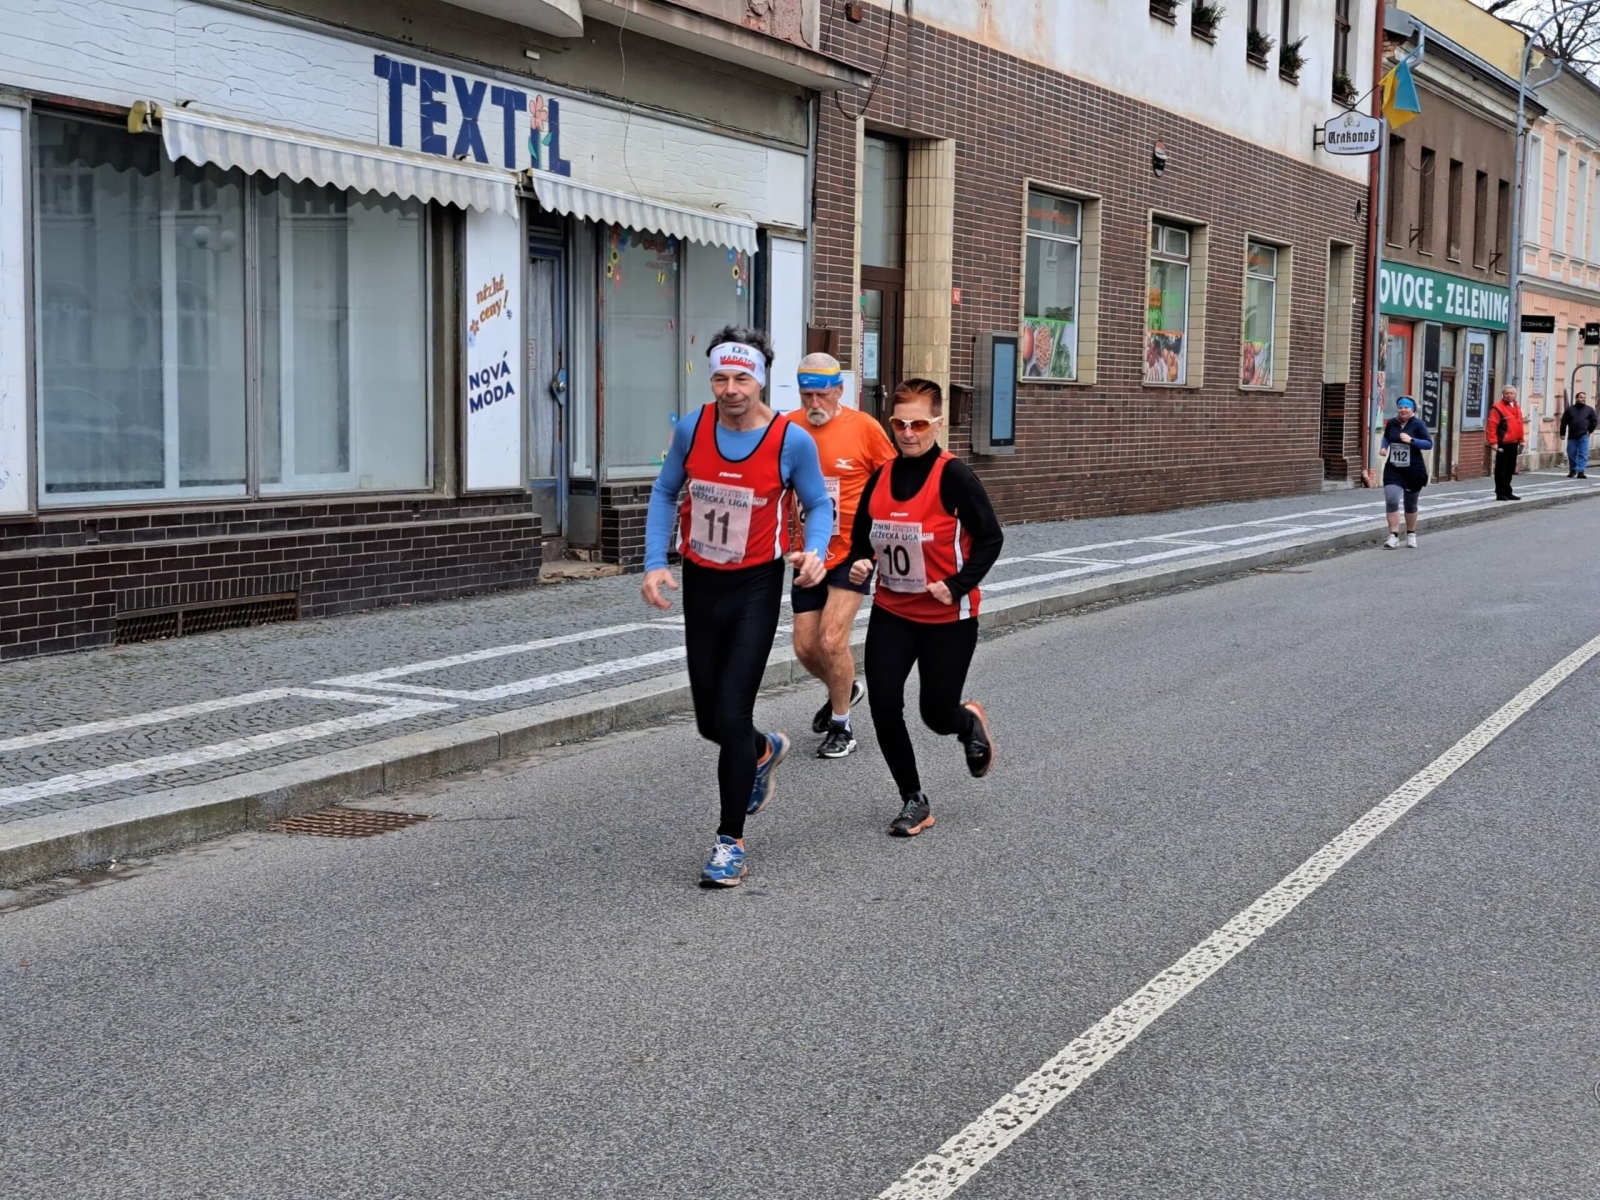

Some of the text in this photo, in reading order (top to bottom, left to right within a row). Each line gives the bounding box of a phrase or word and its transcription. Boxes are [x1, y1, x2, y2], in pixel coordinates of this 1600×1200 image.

[374, 54, 571, 178] TEXTIL
[476, 274, 505, 305] nízké
[1379, 268, 1434, 311] OVOCE
[1445, 282, 1509, 324] ZELENINA
[479, 289, 509, 324] ceny!
[469, 350, 511, 390] NOVÁ
[469, 381, 515, 414] MÓDA
[1393, 450, 1408, 462] 112
[729, 499, 748, 509] LIGA
[704, 509, 730, 545] 11
[873, 523, 891, 531] ZIMNÍ
[883, 544, 910, 576] 10
